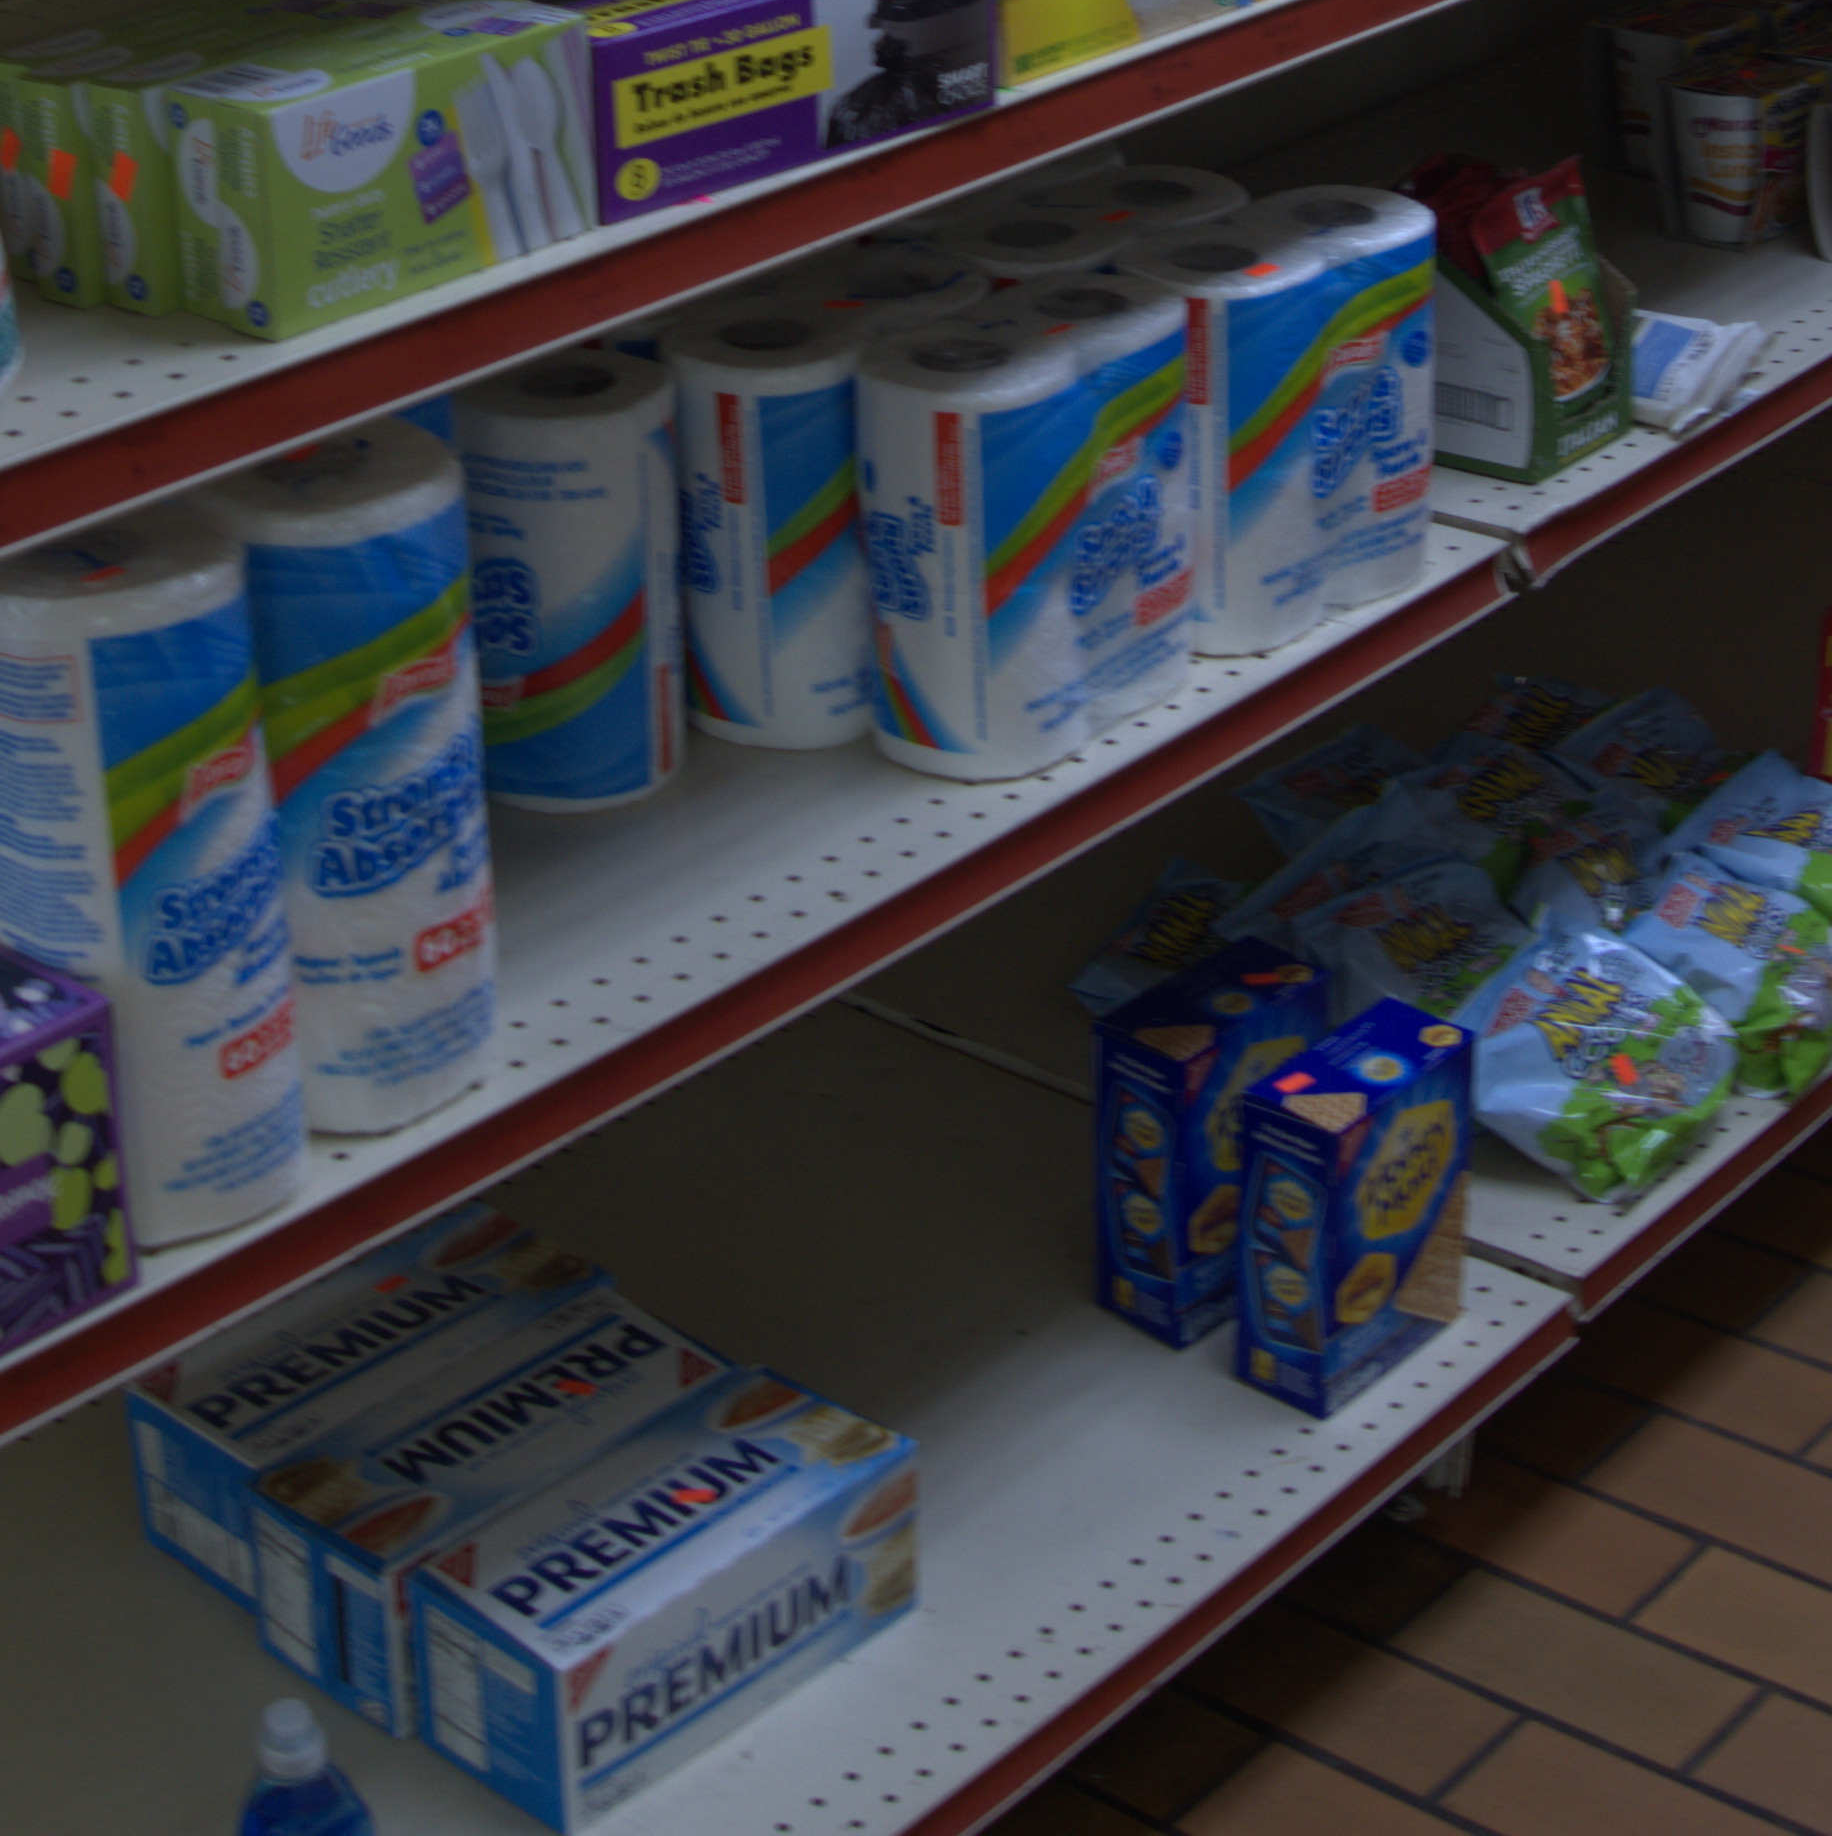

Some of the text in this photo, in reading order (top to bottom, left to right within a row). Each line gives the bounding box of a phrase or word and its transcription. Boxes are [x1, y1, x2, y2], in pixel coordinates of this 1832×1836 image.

[633, 44, 815, 113] Trash Bags
[185, 1272, 490, 1432] PREMIUM
[380, 1320, 668, 1486] PREMIUM
[489, 1436, 782, 1618] PREMIUM
[575, 1552, 858, 1768] PREMIUM
